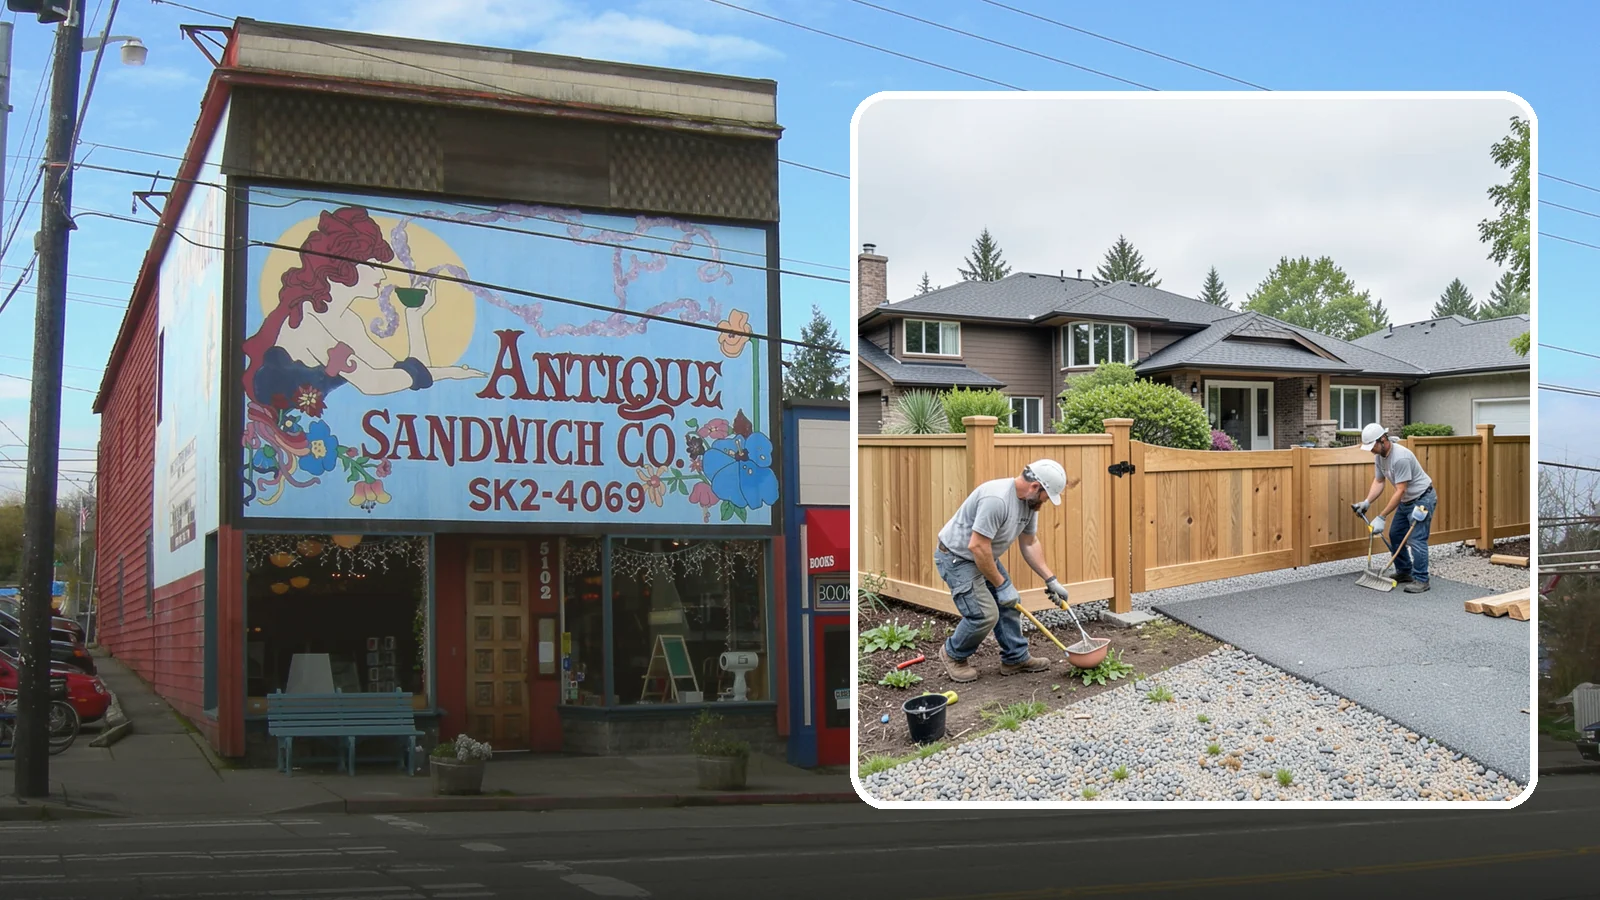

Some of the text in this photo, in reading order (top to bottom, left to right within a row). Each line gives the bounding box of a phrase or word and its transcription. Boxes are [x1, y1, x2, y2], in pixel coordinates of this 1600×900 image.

[476, 329, 723, 421] ANTIQUE
[361, 409, 685, 468] SANDWICH CO.
[468, 477, 645, 514] SK2-4069
[539, 541, 552, 600] 5102
[809, 555, 835, 569] BOOKS
